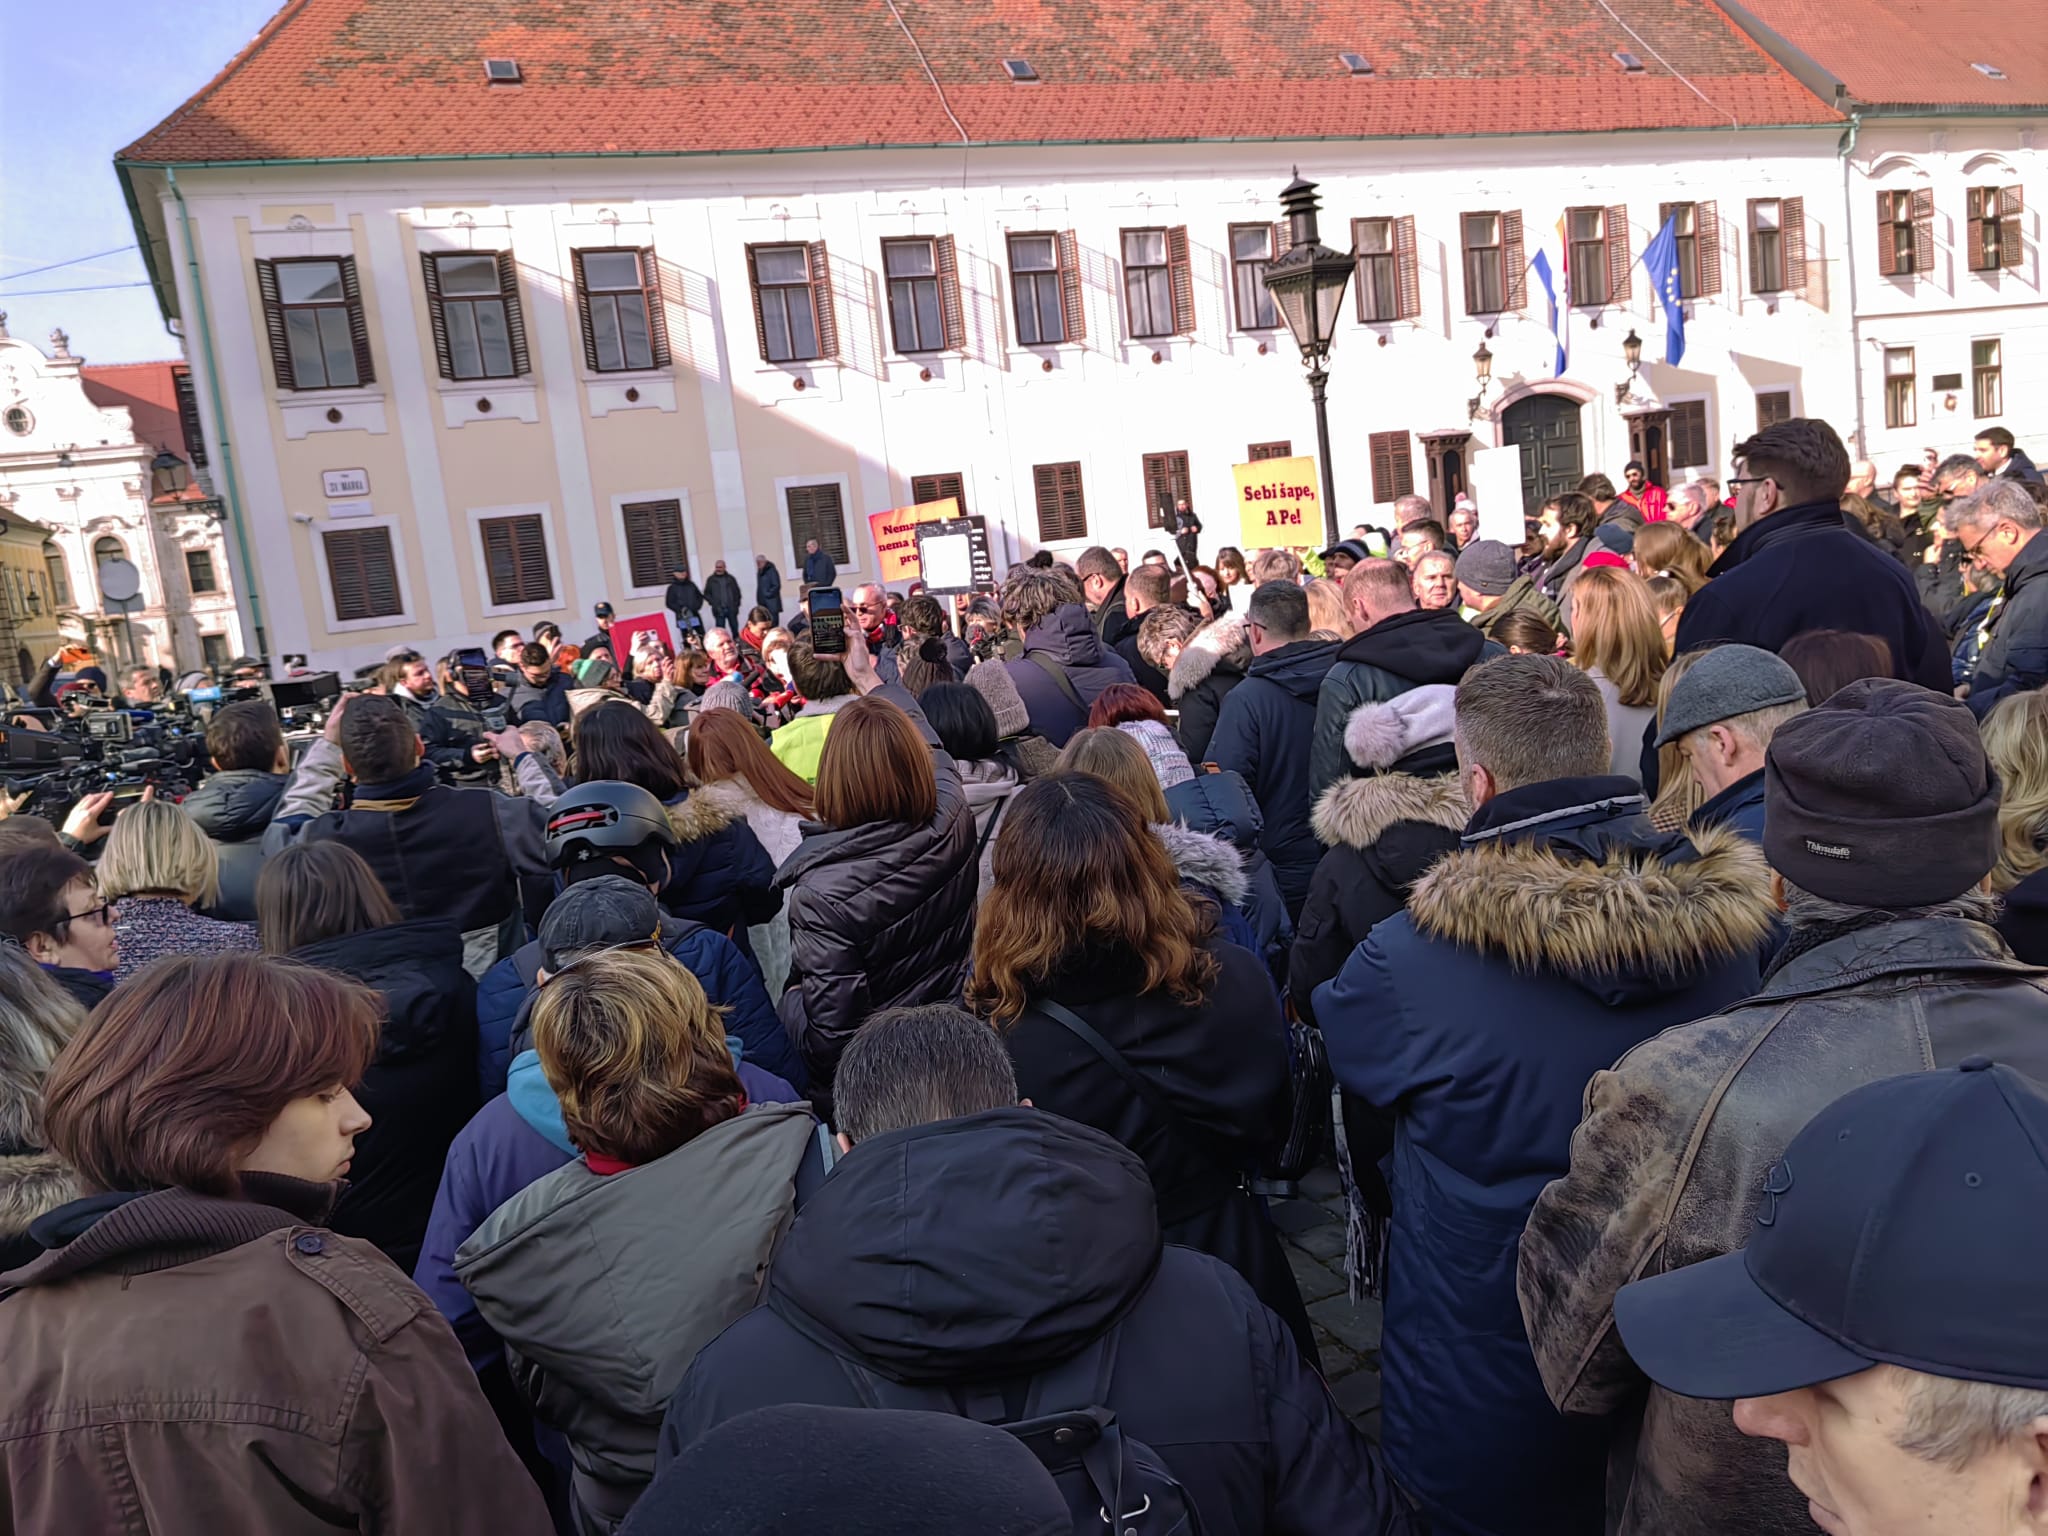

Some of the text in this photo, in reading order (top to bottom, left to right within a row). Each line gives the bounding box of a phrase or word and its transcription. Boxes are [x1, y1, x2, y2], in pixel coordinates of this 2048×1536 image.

[1244, 482, 1315, 501] Sebi šape,
[882, 523, 915, 535] Nema
[878, 540, 909, 552] nema
